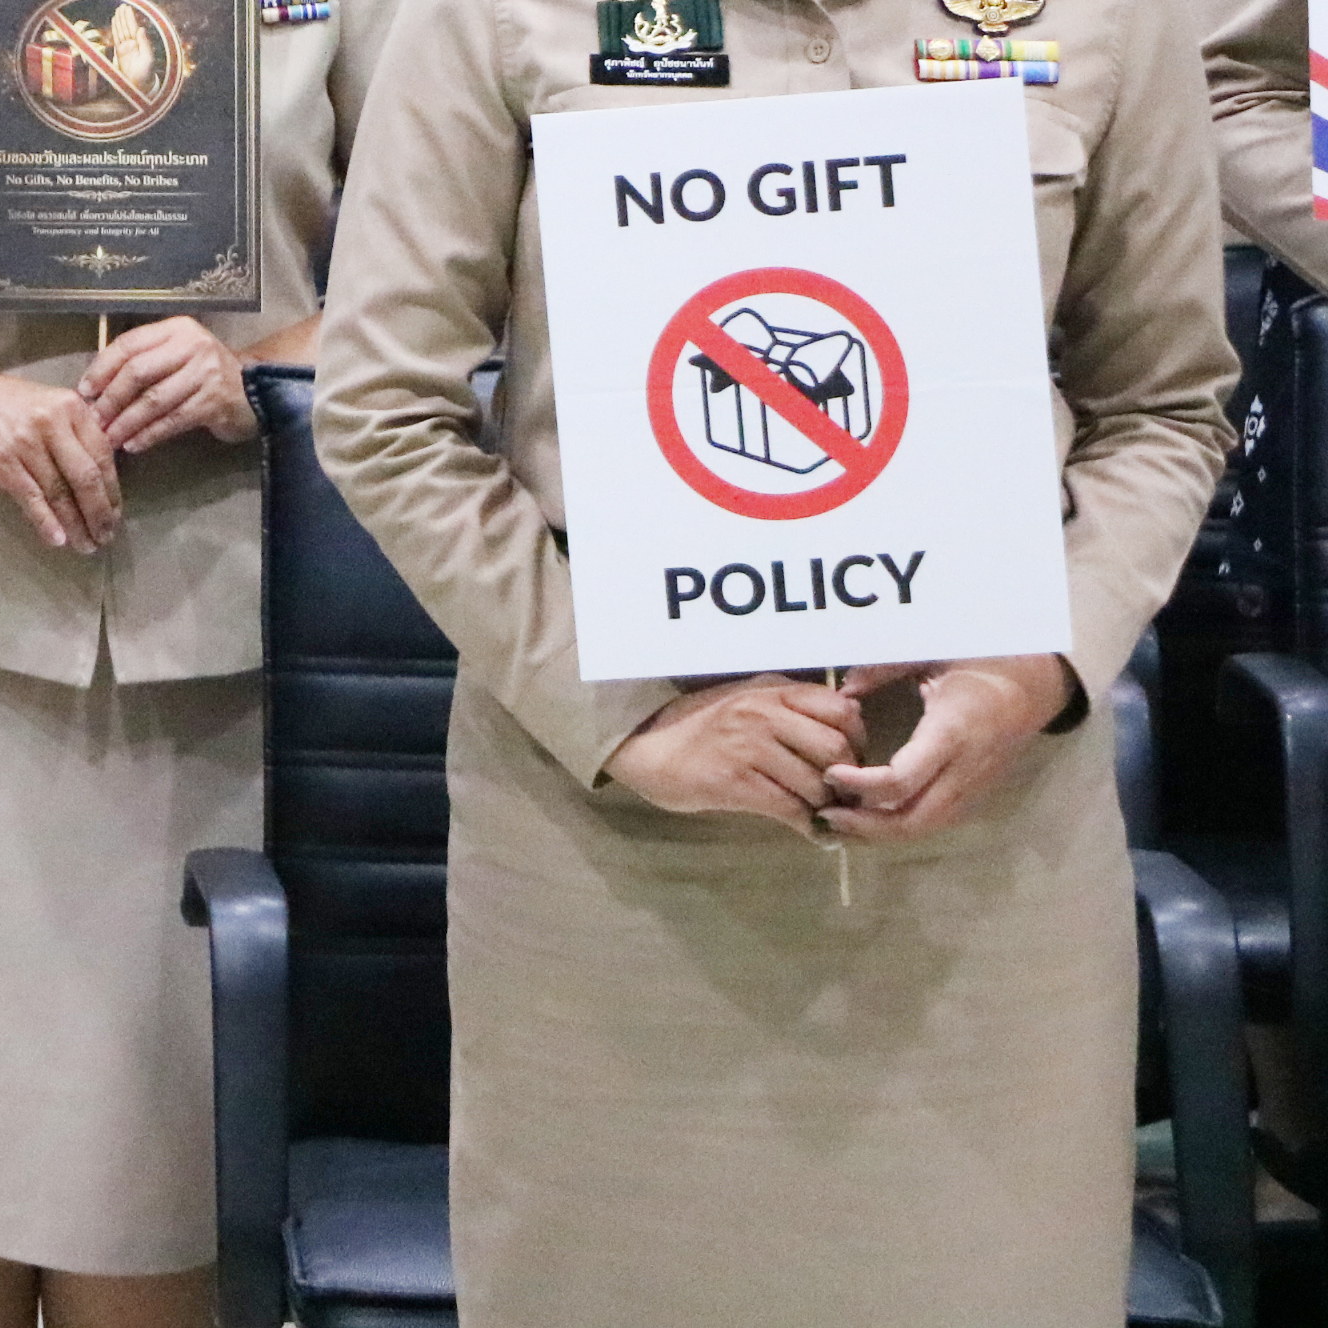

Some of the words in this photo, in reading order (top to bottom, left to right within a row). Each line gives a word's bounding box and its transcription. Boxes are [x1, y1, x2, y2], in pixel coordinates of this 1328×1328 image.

[5, 174, 23, 186] No
[56, 174, 73, 186] No
[75, 174, 122, 188] Benefits,
[124, 174, 141, 186] No
[143, 174, 179, 186] Bribes
[614, 168, 726, 227] NO
[747, 154, 907, 216] GIFT
[664, 550, 926, 620] POLICY
